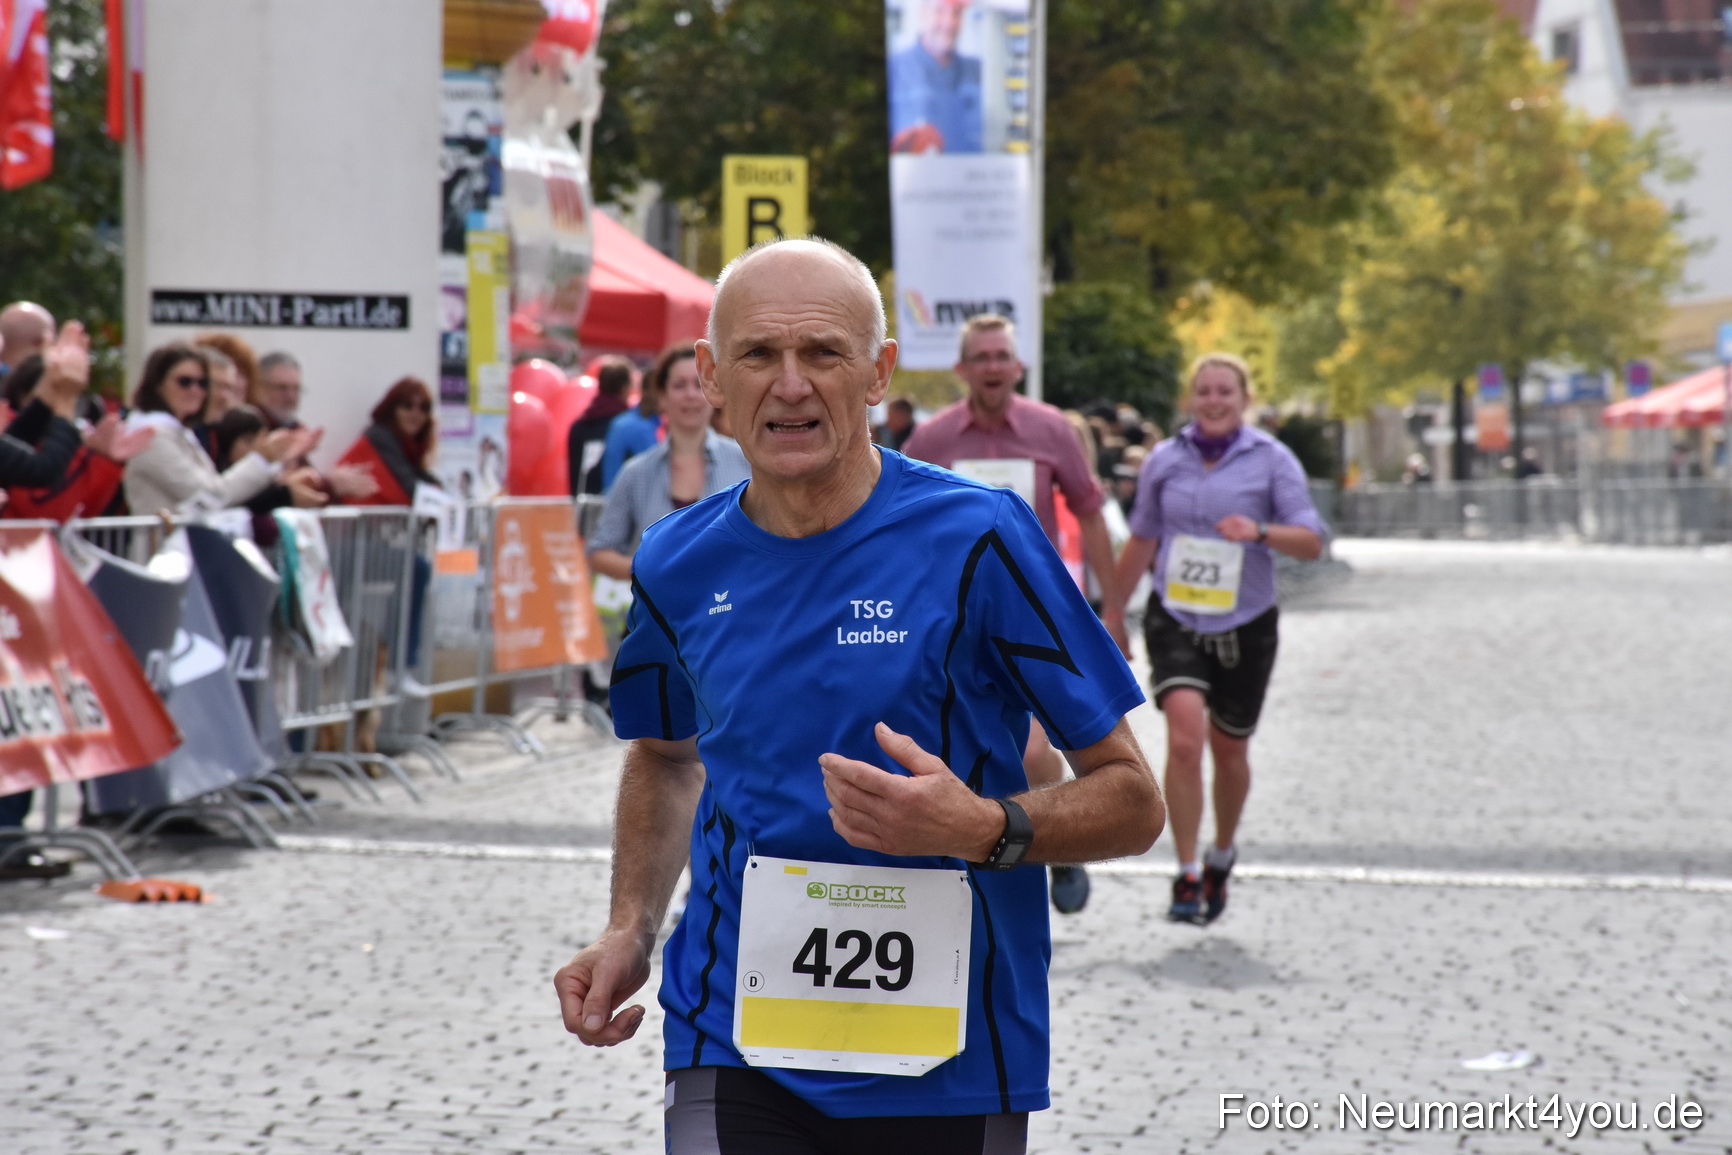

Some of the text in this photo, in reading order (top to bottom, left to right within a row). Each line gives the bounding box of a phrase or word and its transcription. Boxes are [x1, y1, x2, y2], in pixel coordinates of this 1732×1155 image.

[746, 196, 783, 248] B
[1180, 558, 1220, 586] 223
[708, 604, 732, 615] erima
[850, 599, 894, 619] TSG
[837, 624, 908, 645] Laaber
[829, 883, 906, 903] BOCK
[792, 927, 914, 992] 429
[749, 976, 758, 987] D
